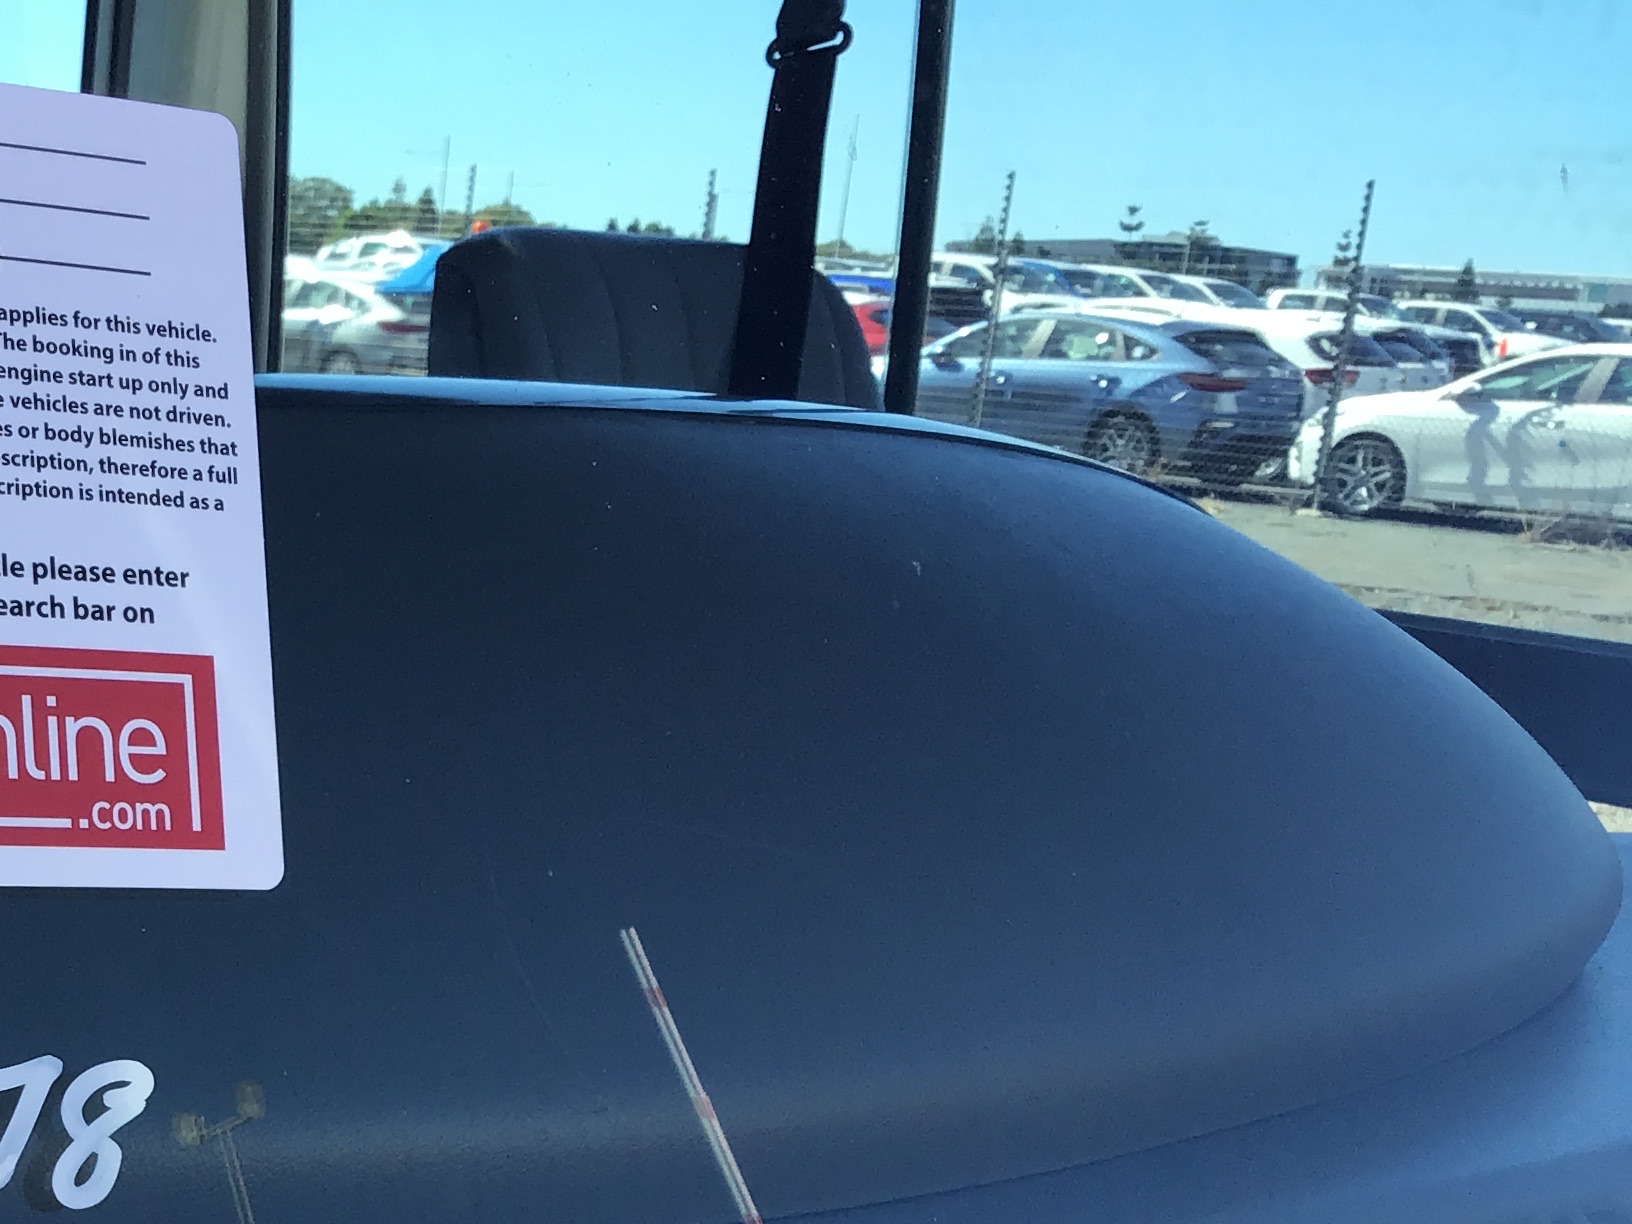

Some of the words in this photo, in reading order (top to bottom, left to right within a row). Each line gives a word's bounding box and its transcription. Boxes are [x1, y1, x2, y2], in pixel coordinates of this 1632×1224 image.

[71, 309, 102, 331] for
[104, 313, 142, 335] this
[144, 319, 218, 344] vehicle.
[31, 333, 115, 364] booking
[118, 342, 138, 363] in
[141, 346, 162, 366] of
[164, 348, 201, 370] this
[67, 369, 115, 390] start
[118, 376, 144, 396] up
[147, 376, 190, 401] only
[192, 381, 230, 401] and
[8, 391, 90, 415] vehicles
[92, 402, 125, 419] are
[128, 405, 163, 422] not
[165, 404, 232, 429] driven.
[17, 424, 40, 440] or
[43, 421, 95, 450] body
[98, 426, 196, 454] blemishes
[198, 435, 239, 458] that
[97, 455, 189, 481] therefore
[191, 468, 204, 482] a
[206, 464, 239, 486] full
[78, 481, 95, 502] is
[97, 483, 186, 509] intended
[188, 495, 211, 511] as
[213, 497, 225, 512] a
[31, 555, 117, 586] please
[121, 565, 190, 589] enter
[72, 595, 117, 622] bar
[122, 605, 156, 625] on
[78, 800, 171, 831] .com
